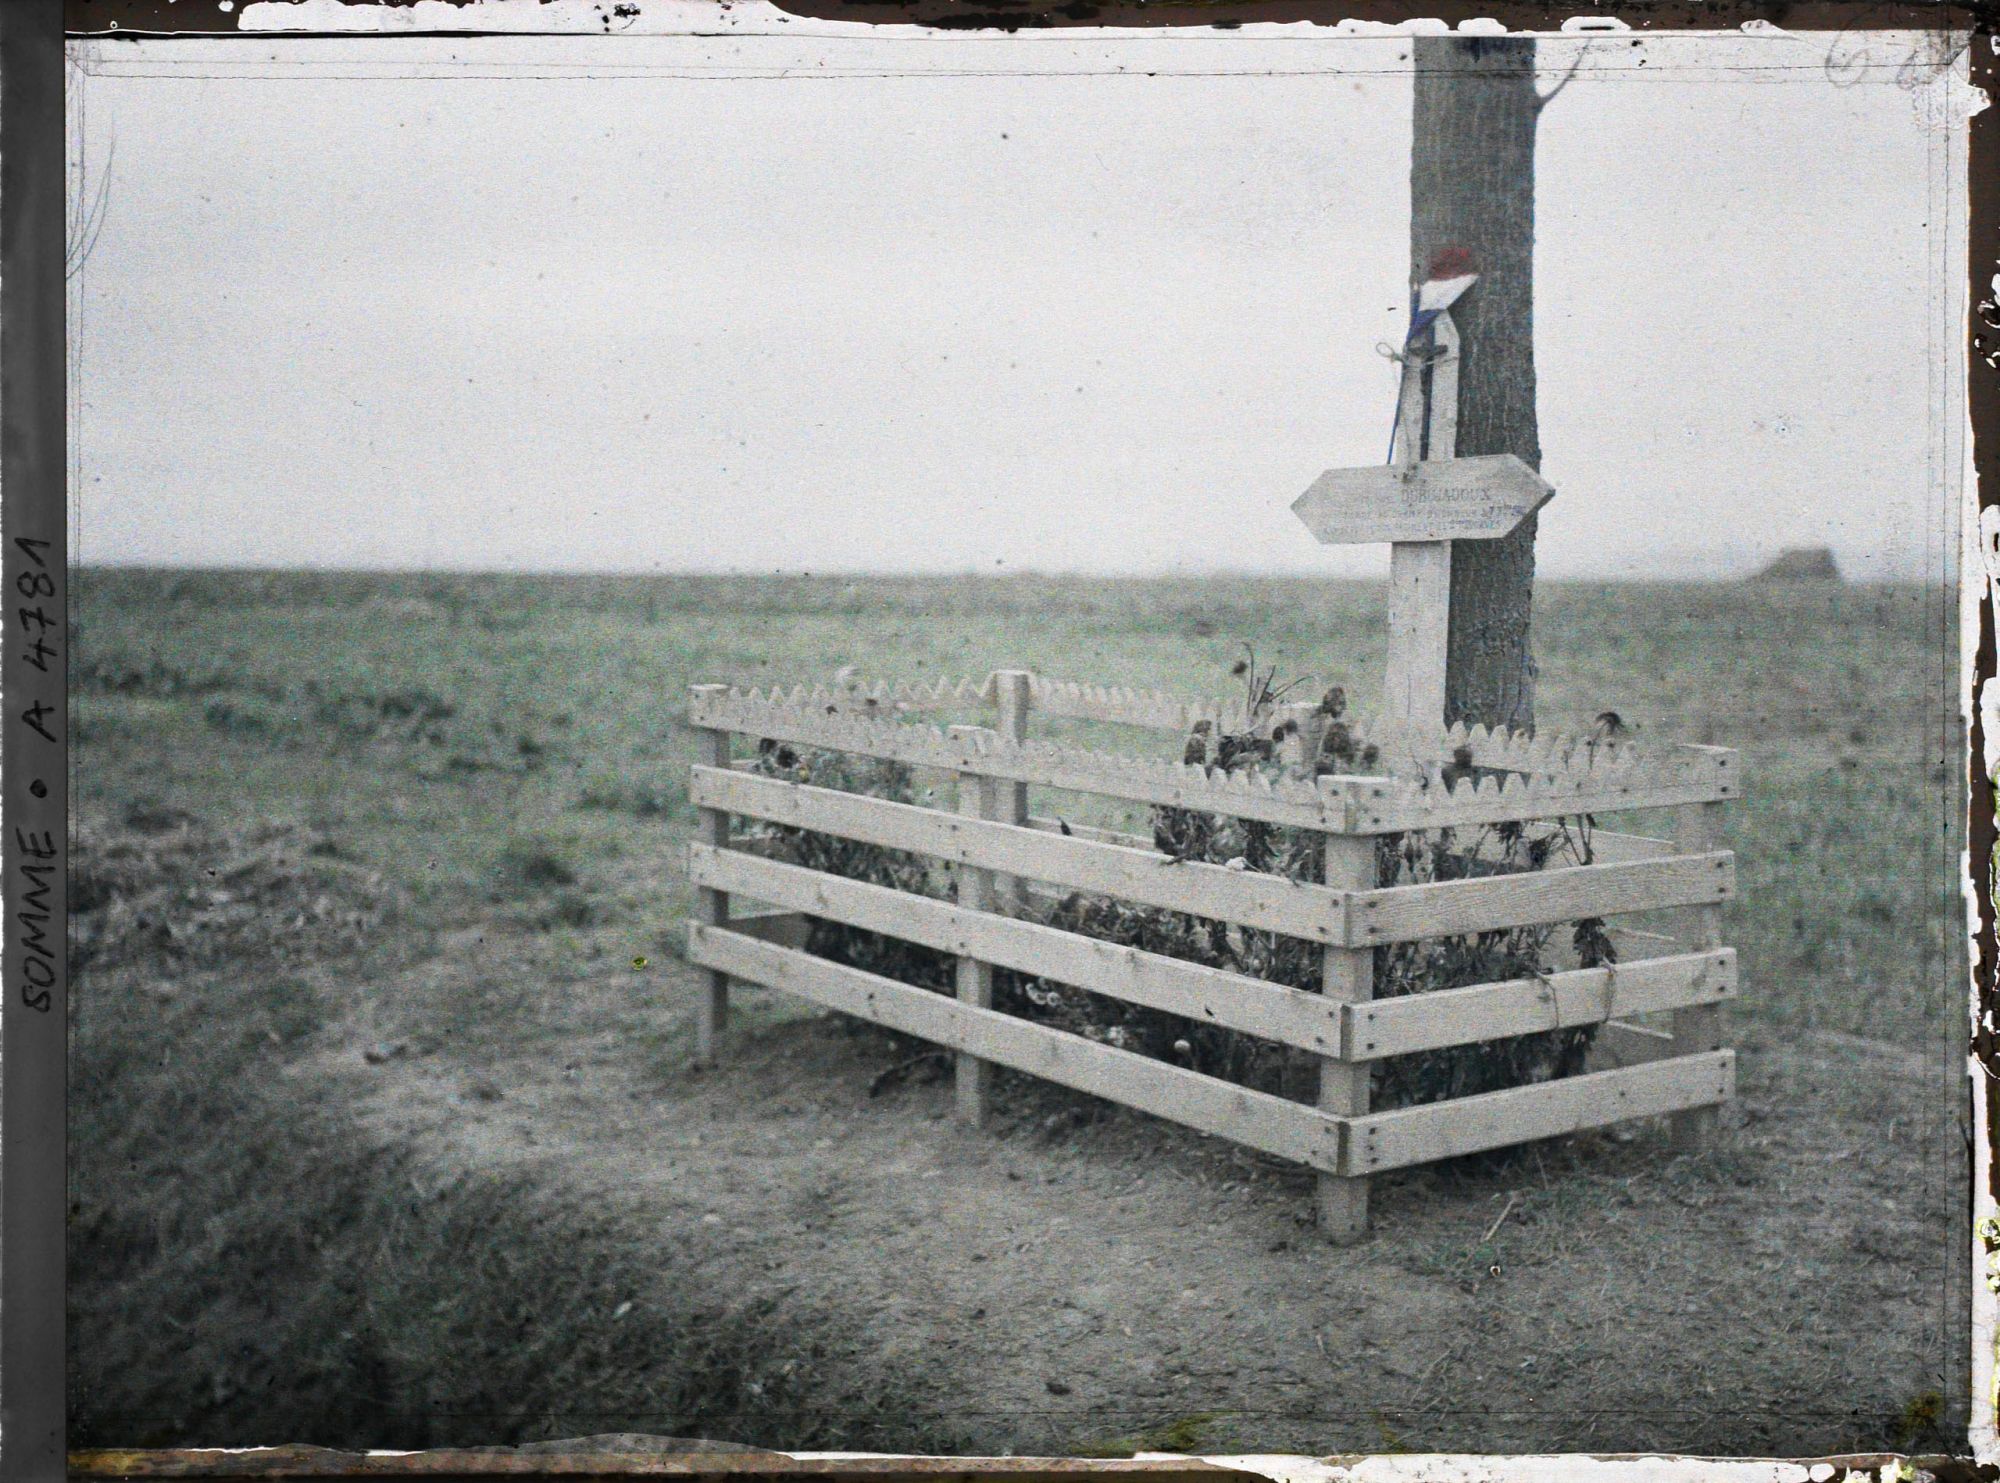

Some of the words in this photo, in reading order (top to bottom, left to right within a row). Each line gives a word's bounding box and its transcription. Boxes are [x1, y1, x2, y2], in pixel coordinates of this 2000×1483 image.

[15, 537, 57, 672] 4781
[21, 701, 57, 743] A
[16, 826, 56, 1013] SOMME
